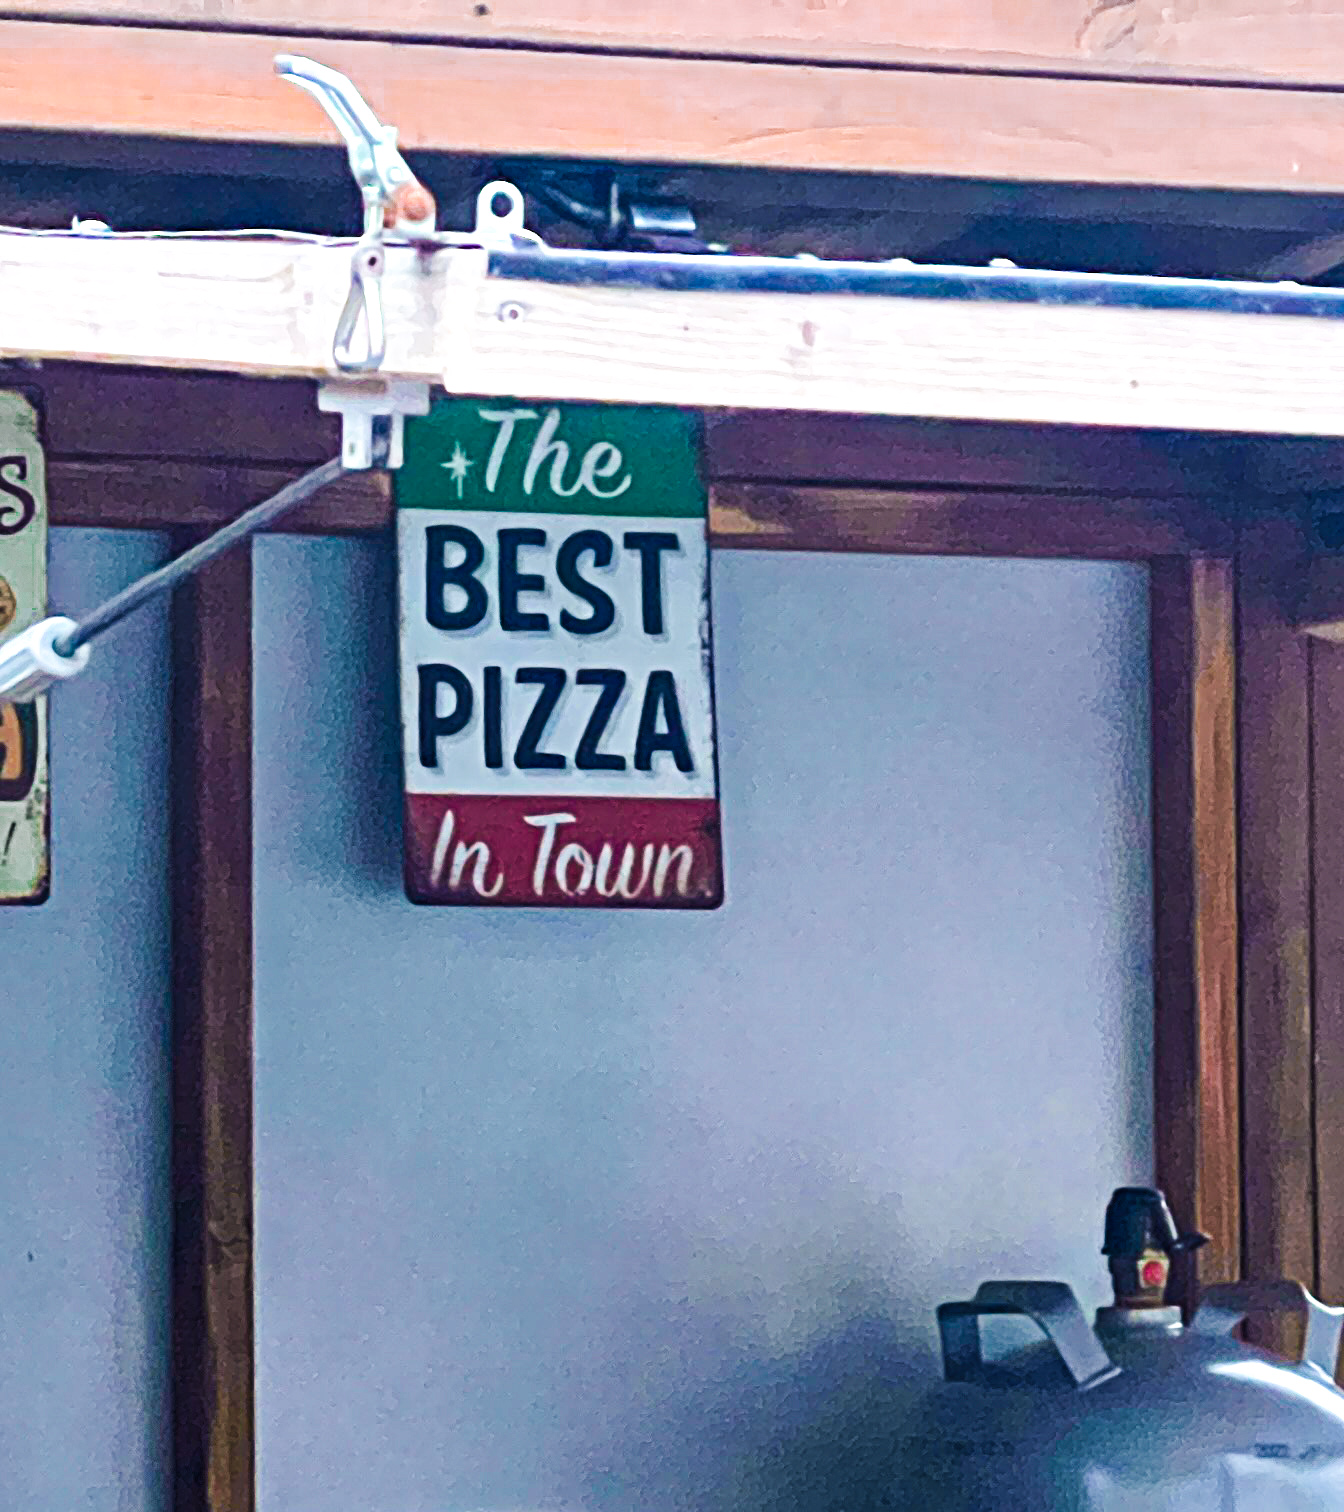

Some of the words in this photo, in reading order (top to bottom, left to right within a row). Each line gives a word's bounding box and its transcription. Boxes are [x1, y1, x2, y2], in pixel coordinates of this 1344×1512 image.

[478, 407, 633, 499] The
[425, 524, 681, 636] BEST
[417, 662, 696, 774] PIZZA
[429, 808, 504, 898] In
[522, 811, 696, 899] Town
